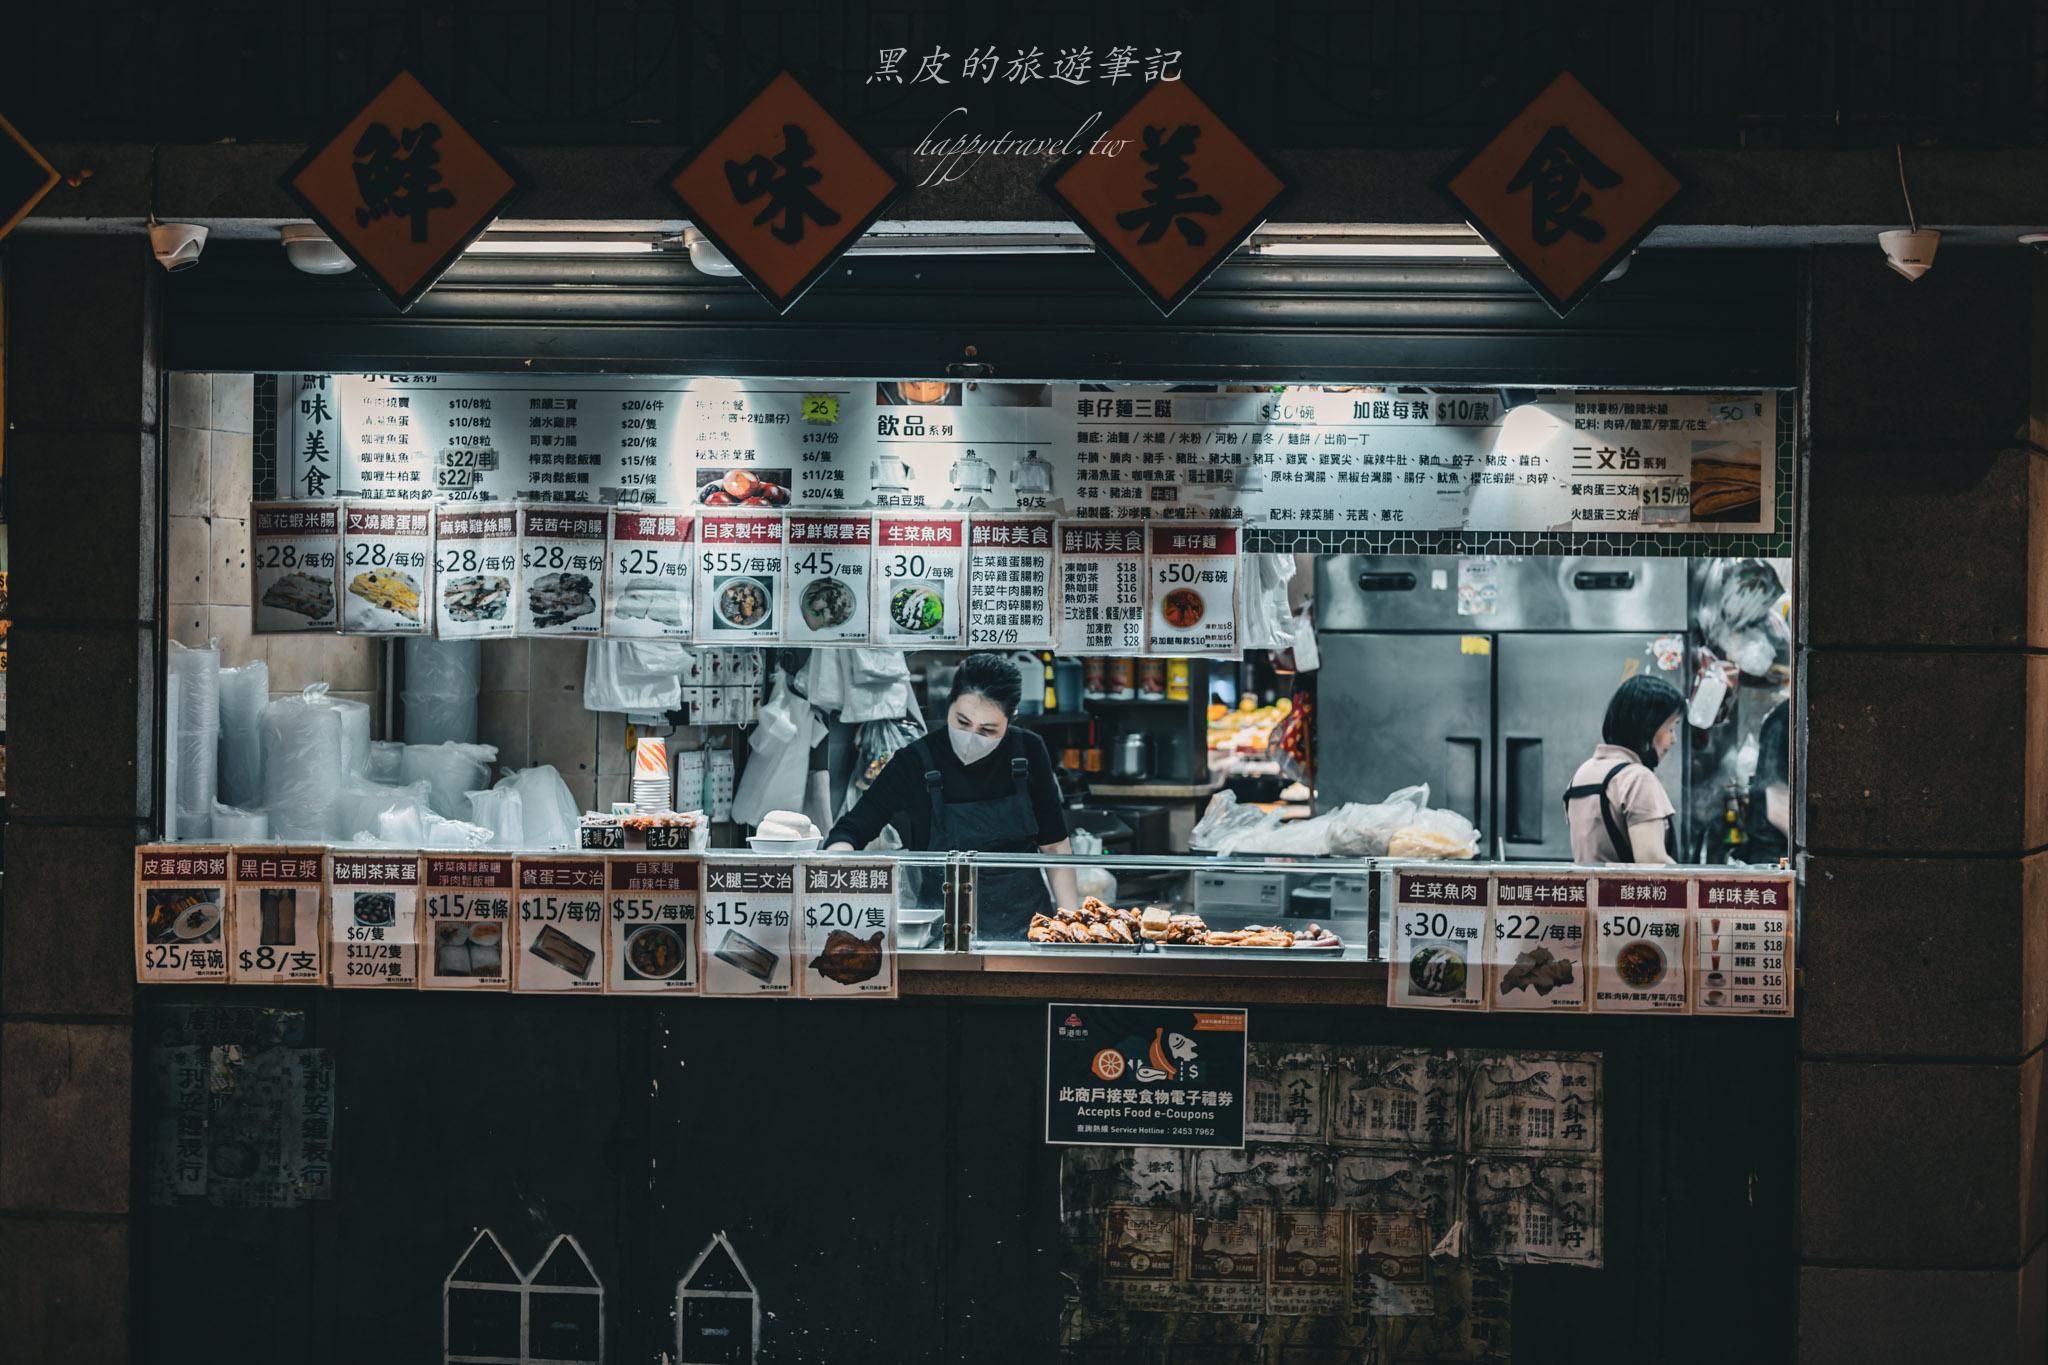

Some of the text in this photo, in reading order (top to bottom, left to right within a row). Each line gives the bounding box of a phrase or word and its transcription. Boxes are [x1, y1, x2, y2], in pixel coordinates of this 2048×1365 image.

[354, 123, 1621, 248] 鮮 味 美 食
[449, 399, 491, 410] $10/8粒
[622, 400, 664, 411] $20/6件
[811, 401, 828, 415] 26
[1438, 400, 1489, 421] $10/款
[449, 417, 491, 428] $10/8粒
[878, 415, 953, 436] 飲品系列
[449, 436, 491, 446] $10/8粒
[803, 433, 839, 444] $13/份
[447, 451, 491, 468] $22/串
[1572, 447, 1666, 470] 三文治系列
[1017, 497, 1046, 508] $8/支
[1643, 486, 1689, 505] $15/份
[350, 514, 427, 530] 叉燒雞蛋腸
[440, 518, 512, 535] 麻辣雞絲腸
[704, 523, 783, 539] 自家製牛雜
[791, 523, 870, 539] 淨鮮蝦雲吞
[888, 526, 952, 542] 生菜魚肉
[973, 526, 1049, 544] 鮮味美食
[1065, 531, 1142, 551] 鮮味美食
[1173, 535, 1216, 549] 車仔麵
[256, 545, 335, 569] $28/每份
[346, 544, 425, 567] $28/每份
[436, 550, 515, 573] $28/每份
[523, 546, 603, 571] $28/每份
[620, 550, 687, 577] $25/每份
[703, 552, 782, 573] $55/每碗
[972, 556, 1044, 568] 生菜雞蛋腸粉
[794, 552, 863, 576] $45/每碗
[885, 555, 954, 579] $30/每碗
[1117, 563, 1136, 572] $18
[972, 571, 1044, 582] 肉碎雞蛋腸粉
[1117, 573, 1136, 583] $18
[1159, 563, 1228, 584] $50/每碗
[1117, 584, 1136, 593] $16
[972, 600, 1044, 611] 蝦仁肉碎腸粉
[1117, 594, 1136, 603] $16
[972, 614, 1043, 626] 叉燒雞蛋腸粉
[972, 629, 1017, 644] $28/份
[1124, 623, 1139, 634] $30
[1124, 636, 1139, 647] $28
[144, 859, 225, 875] 皮蛋瘦肉粥
[240, 860, 318, 879] 黑白豆漿
[336, 863, 417, 881] 秘制茶葉蛋
[523, 870, 604, 886] 餐蛋三文治
[709, 872, 792, 889] 火腿三文治
[1410, 882, 1477, 900] 生菜魚肉
[1620, 885, 1667, 901] 酸辣粉
[1708, 888, 1777, 905] 鮮味美食
[522, 898, 601, 922] $15/每份
[613, 898, 695, 921] $55/每碗
[706, 902, 790, 927] $15/每份
[806, 903, 886, 929] $20/隻
[1405, 913, 1478, 940] $30/每碗
[1496, 915, 1582, 942] $22/每串
[1603, 916, 1680, 938] $50/每碗
[1764, 921, 1782, 933] $18
[1764, 940, 1782, 951] $18
[145, 945, 224, 970] $25/每碗
[239, 946, 317, 972] $8/支
[1763, 957, 1781, 969] $18
[1763, 975, 1781, 986] $16
[1763, 994, 1781, 1006] $16
[1059, 1087, 1233, 1106] 此商戶接受食物電子禮券
[1077, 1107, 1215, 1120] Accepts Food e-Coupons
[1111, 1126, 1137, 1134] Service
[1195, 1128, 1215, 1136] 7962
